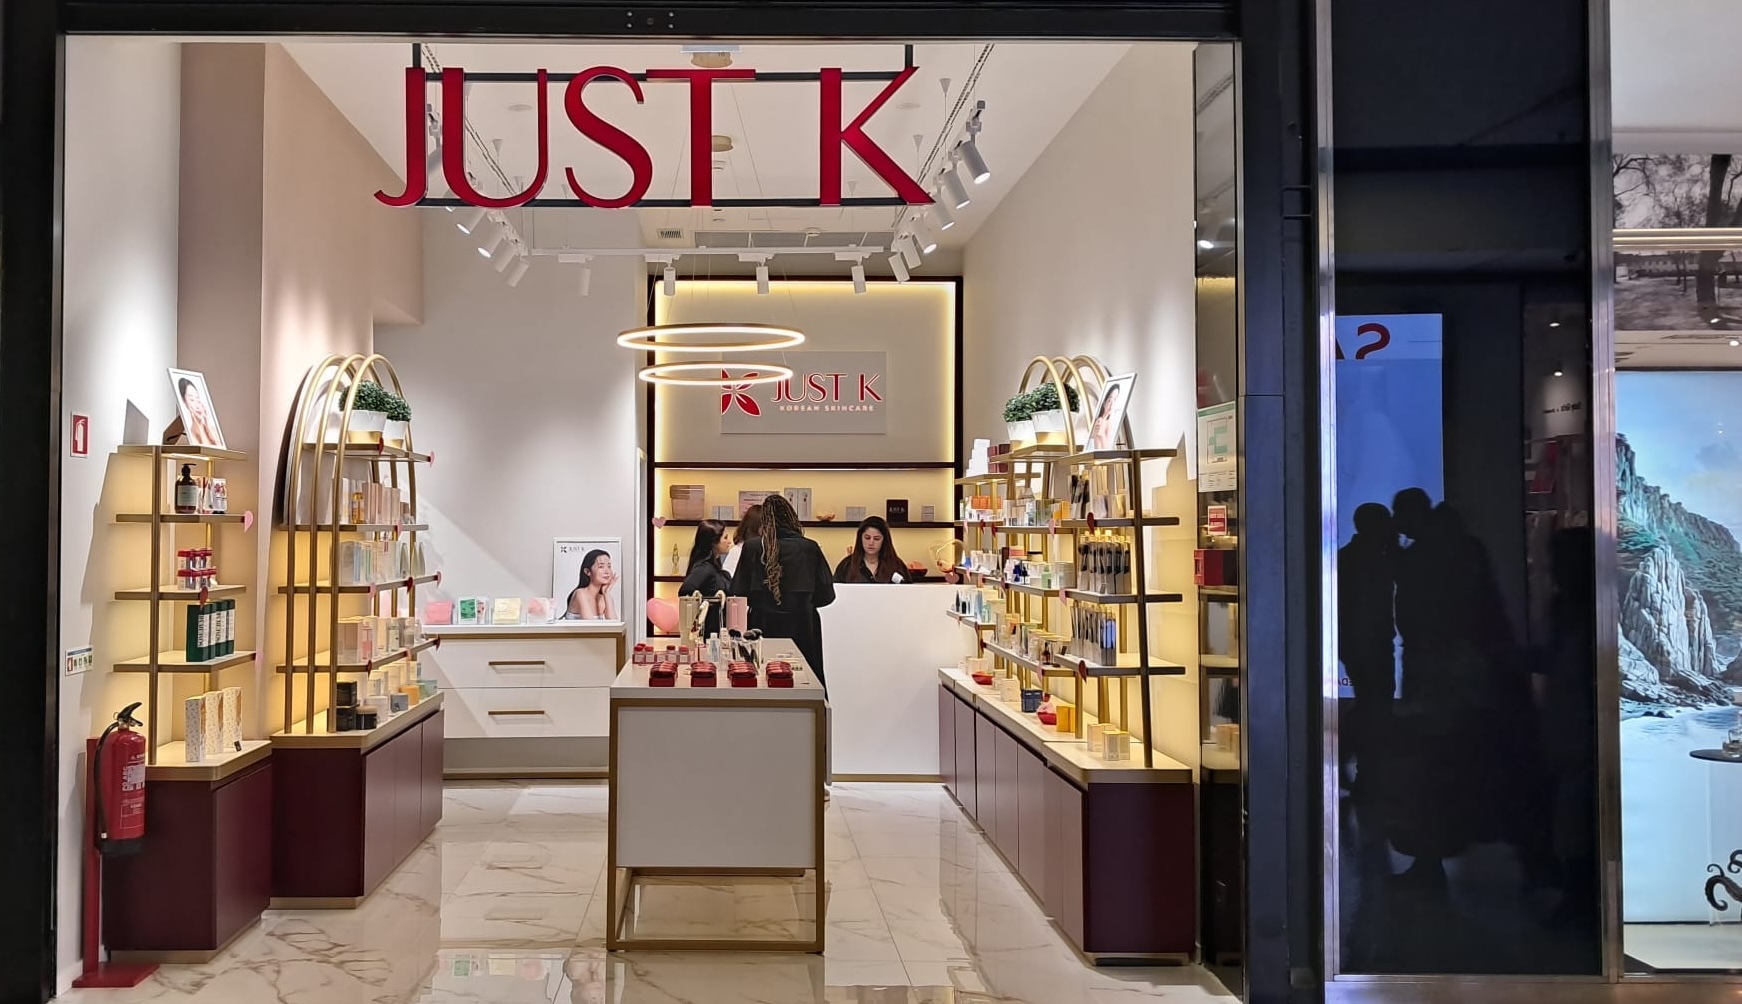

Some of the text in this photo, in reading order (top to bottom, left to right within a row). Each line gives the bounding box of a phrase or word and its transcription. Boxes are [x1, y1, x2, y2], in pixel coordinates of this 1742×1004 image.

[374, 65, 937, 208] JUST K
[771, 373, 883, 402] JUST K
[780, 404, 874, 412] KOREAN SKINCARE
